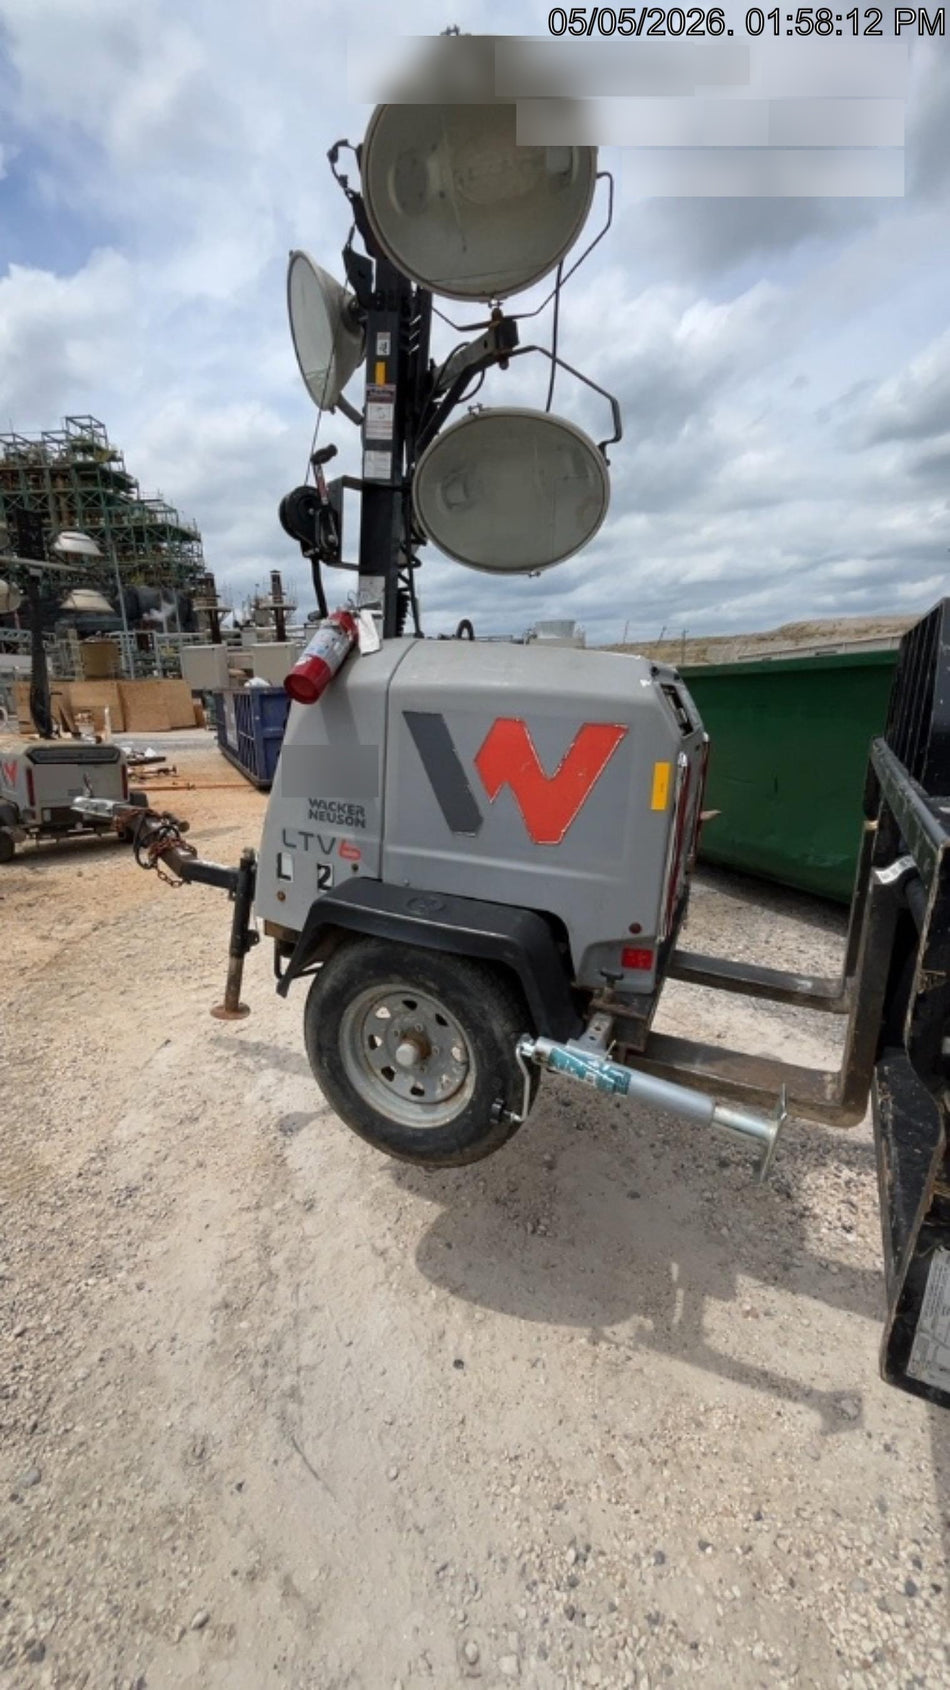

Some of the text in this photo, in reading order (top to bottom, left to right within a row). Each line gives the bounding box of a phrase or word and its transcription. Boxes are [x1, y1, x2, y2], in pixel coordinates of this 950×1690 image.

[308, 798, 365, 818] WACKER
[308, 809, 366, 829] NEUSON
[282, 828, 362, 862] LTV6
[277, 852, 333, 891] L 2
